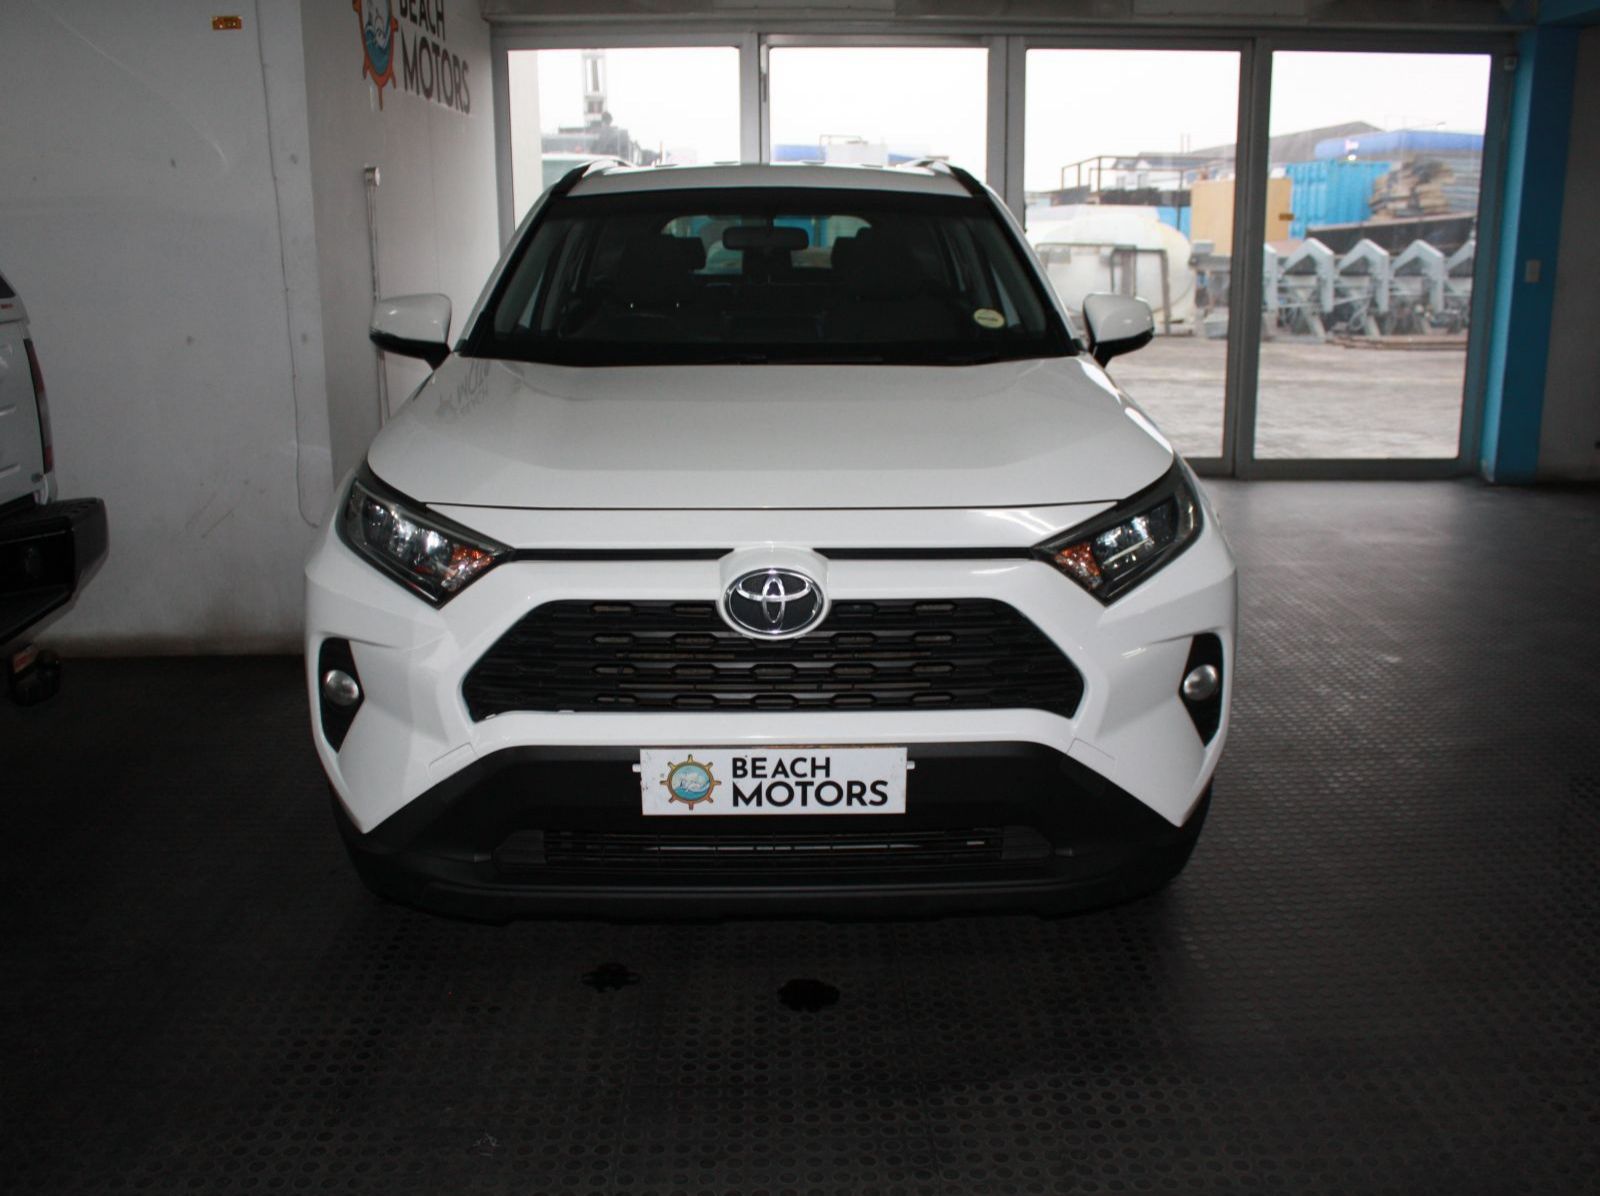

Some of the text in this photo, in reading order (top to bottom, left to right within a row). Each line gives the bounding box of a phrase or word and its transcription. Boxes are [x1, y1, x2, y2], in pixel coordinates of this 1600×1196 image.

[401, 25, 470, 114] MOTORS
[732, 757, 831, 779] BEACH
[732, 780, 888, 807] MOTORS
